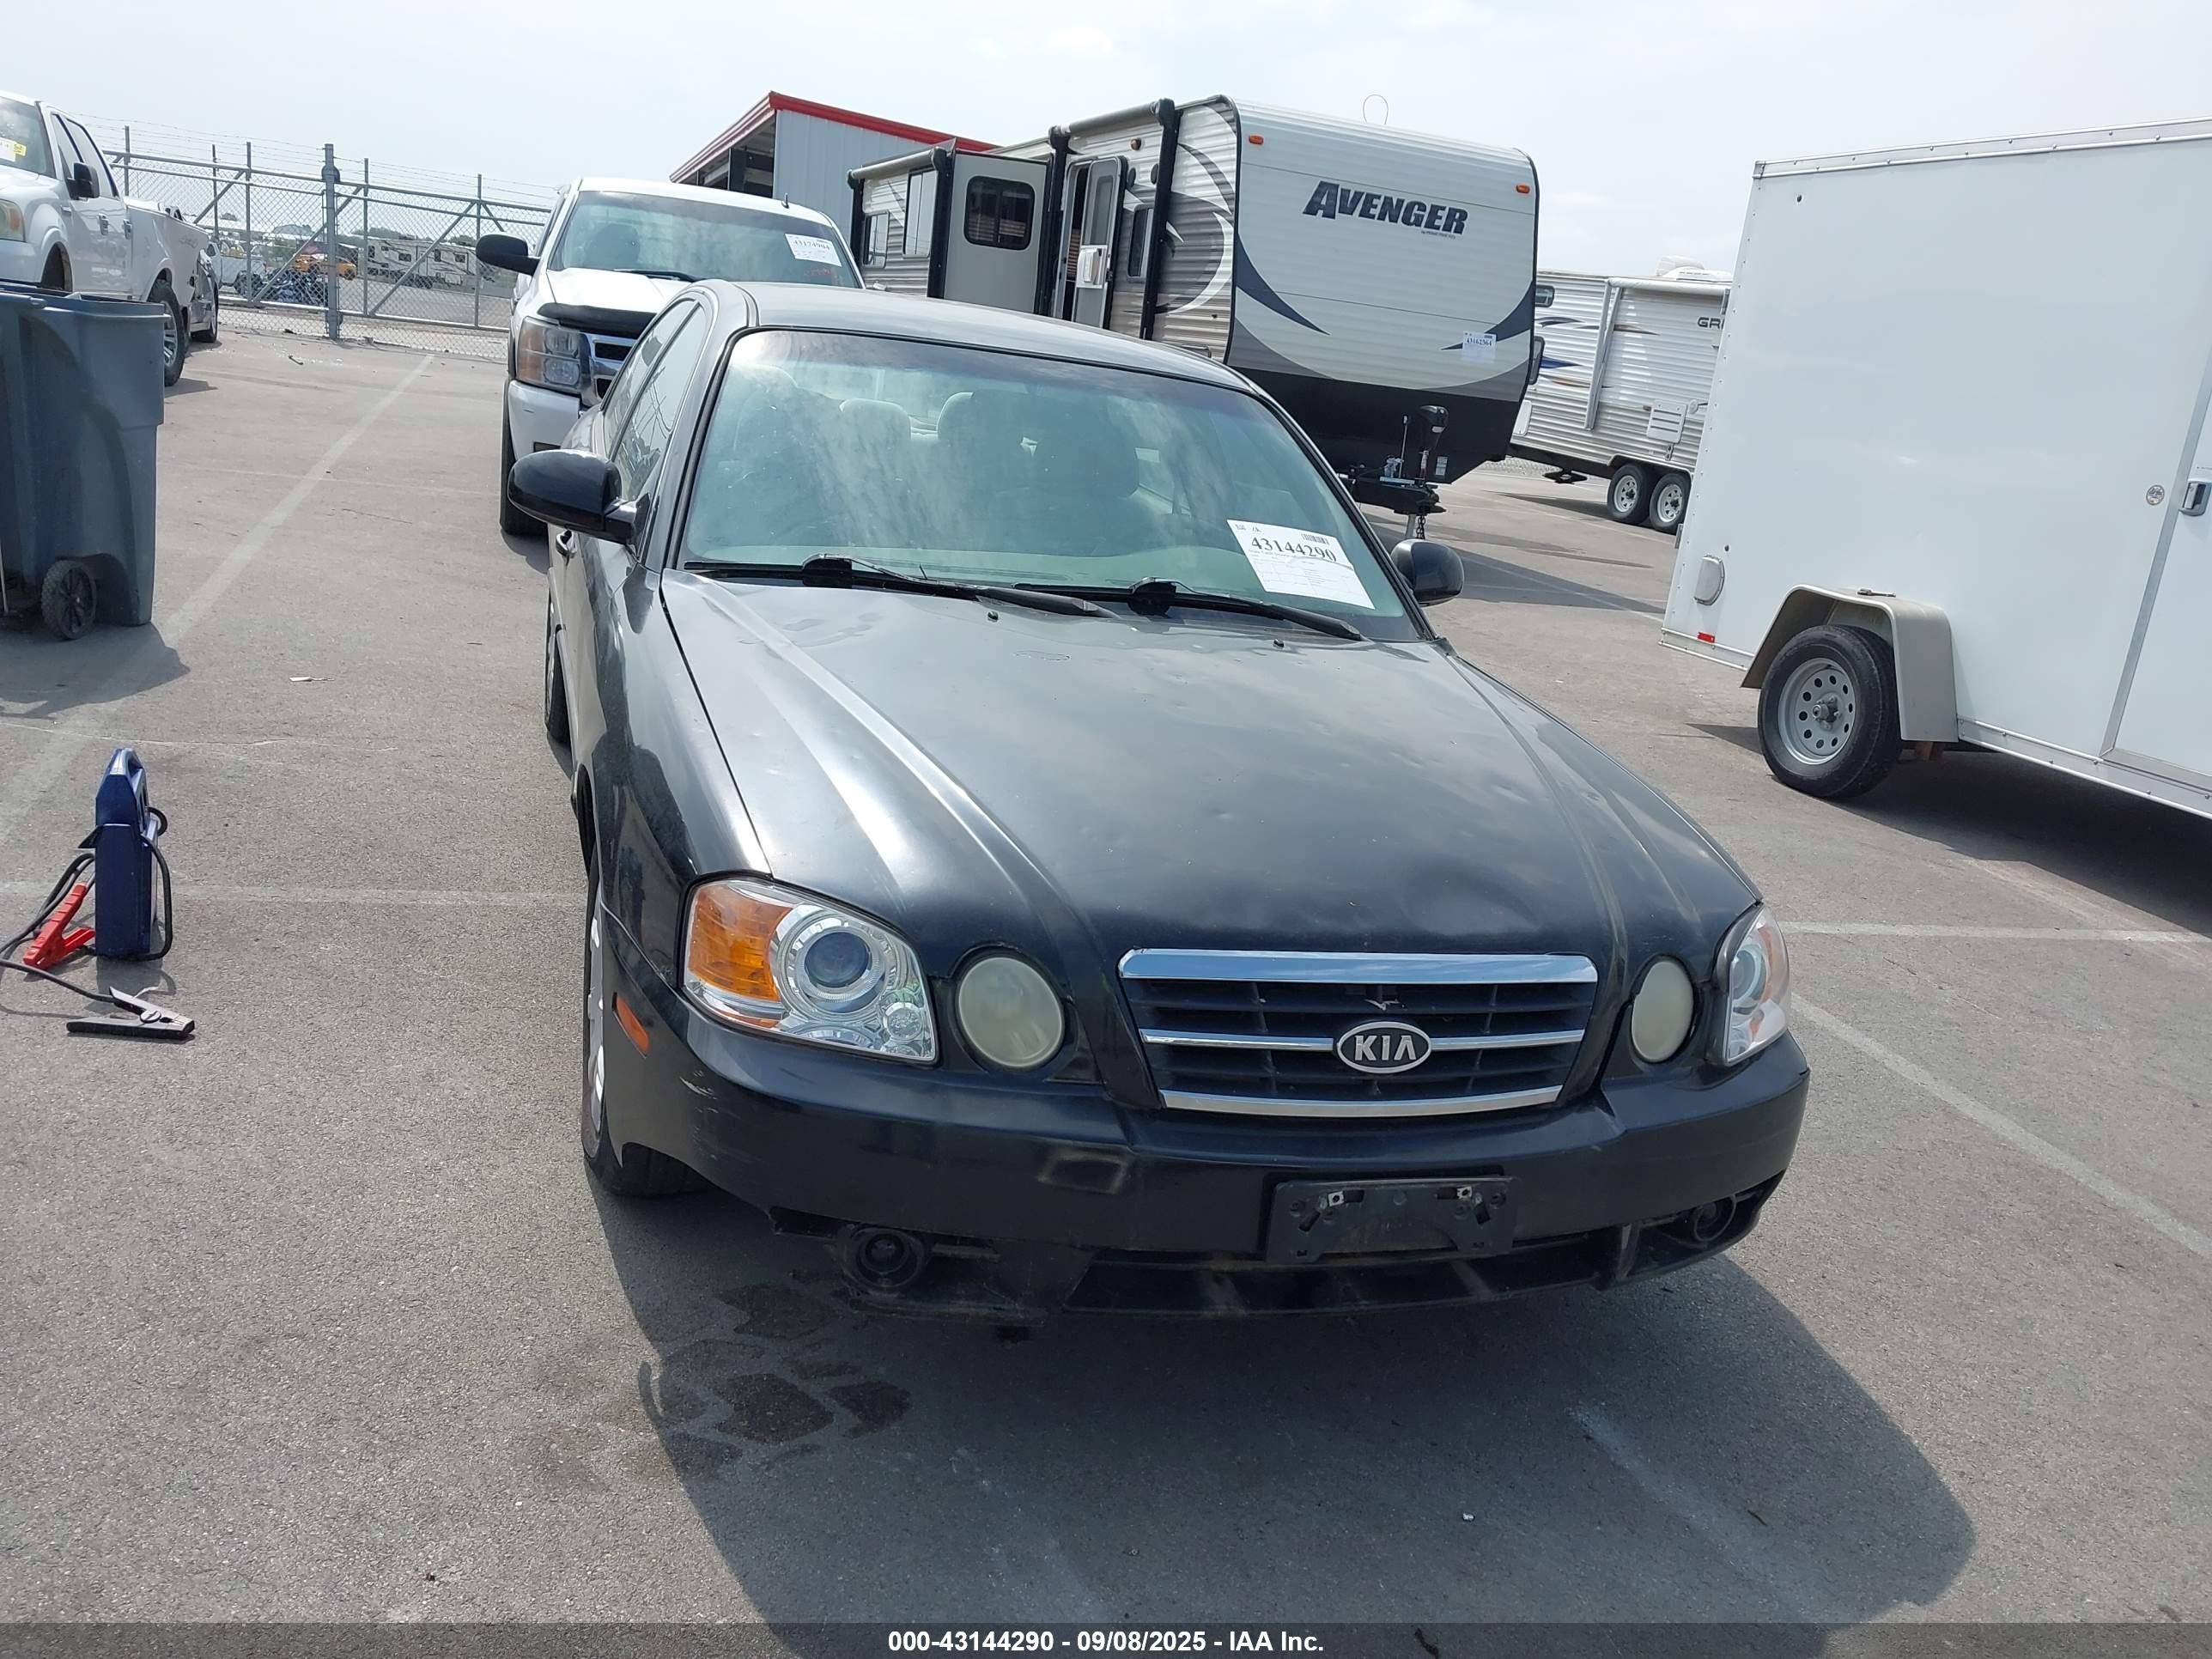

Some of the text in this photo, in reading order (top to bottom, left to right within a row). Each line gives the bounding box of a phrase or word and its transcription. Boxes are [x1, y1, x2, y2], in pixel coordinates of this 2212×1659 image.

[1302, 179, 1469, 235] AVENGER
[1251, 537, 1337, 562] 43144290
[1354, 1034, 1417, 1060] KIA
